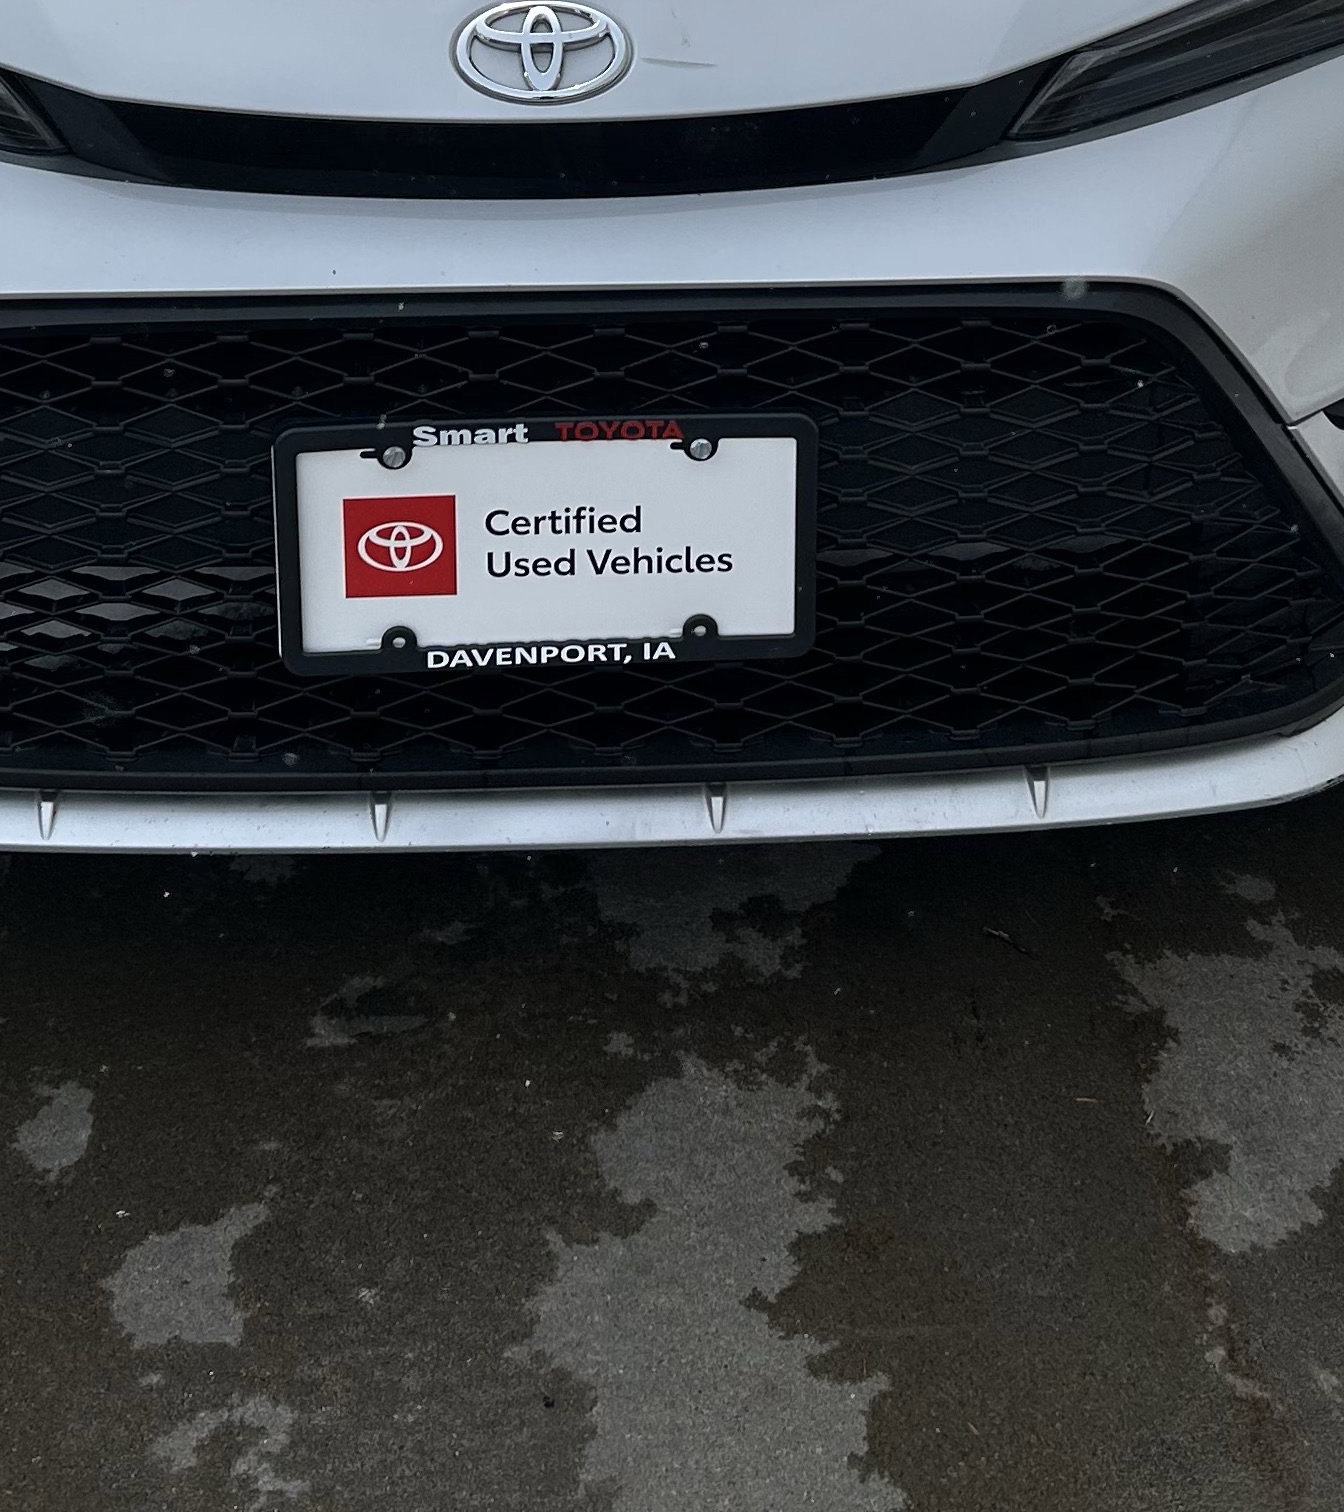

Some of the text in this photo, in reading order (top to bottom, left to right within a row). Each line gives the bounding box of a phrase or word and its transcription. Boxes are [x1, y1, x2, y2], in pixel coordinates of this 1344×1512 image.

[412, 420, 684, 447] Smart TOYOTA
[485, 506, 642, 536] Certified
[487, 546, 734, 578] Used Vehicles
[427, 641, 676, 669] DAVENPORT, IA
